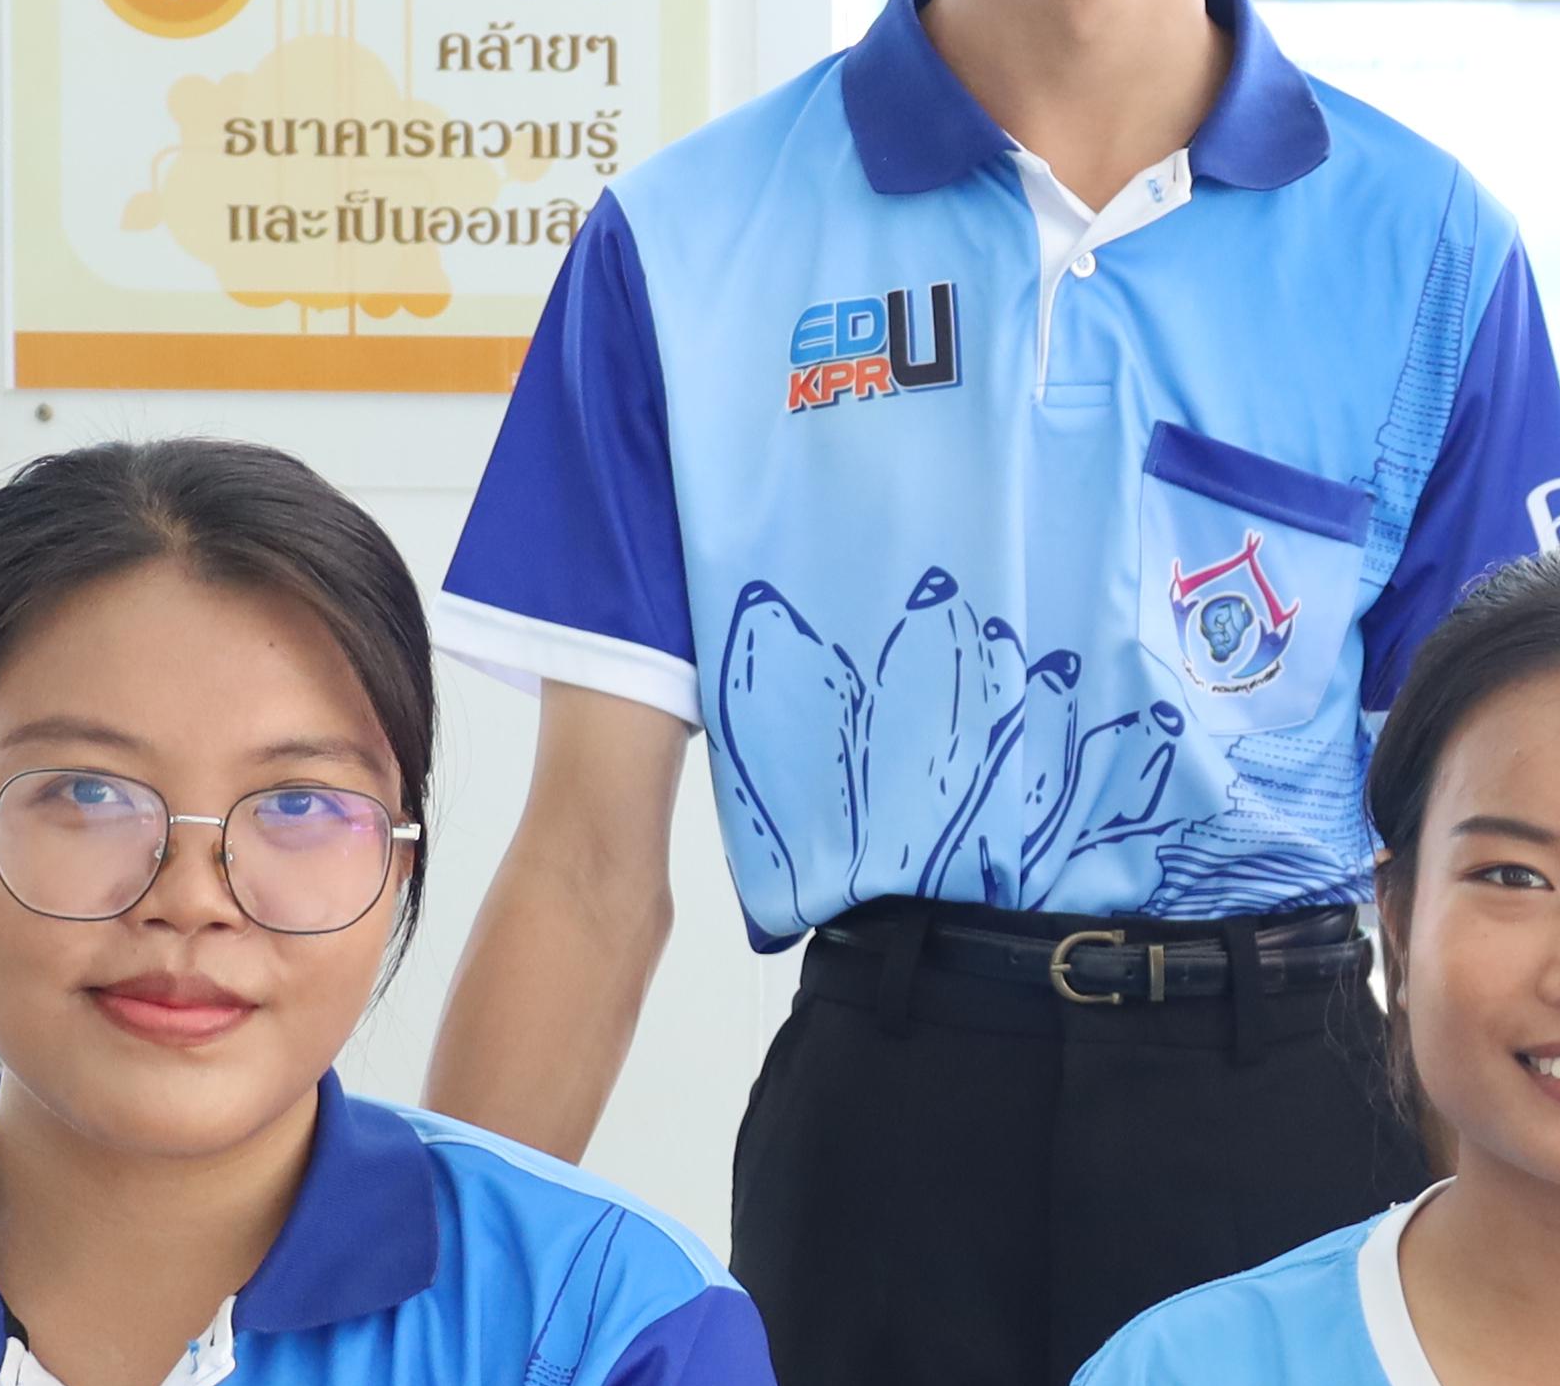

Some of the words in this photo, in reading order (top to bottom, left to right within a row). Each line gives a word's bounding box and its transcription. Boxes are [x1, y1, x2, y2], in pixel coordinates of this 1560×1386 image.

[436, 22, 620, 86] คล้ายๆ
[223, 110, 622, 175] ธนาคารความรู้
[227, 189, 590, 247] และเป็นออมสิ
